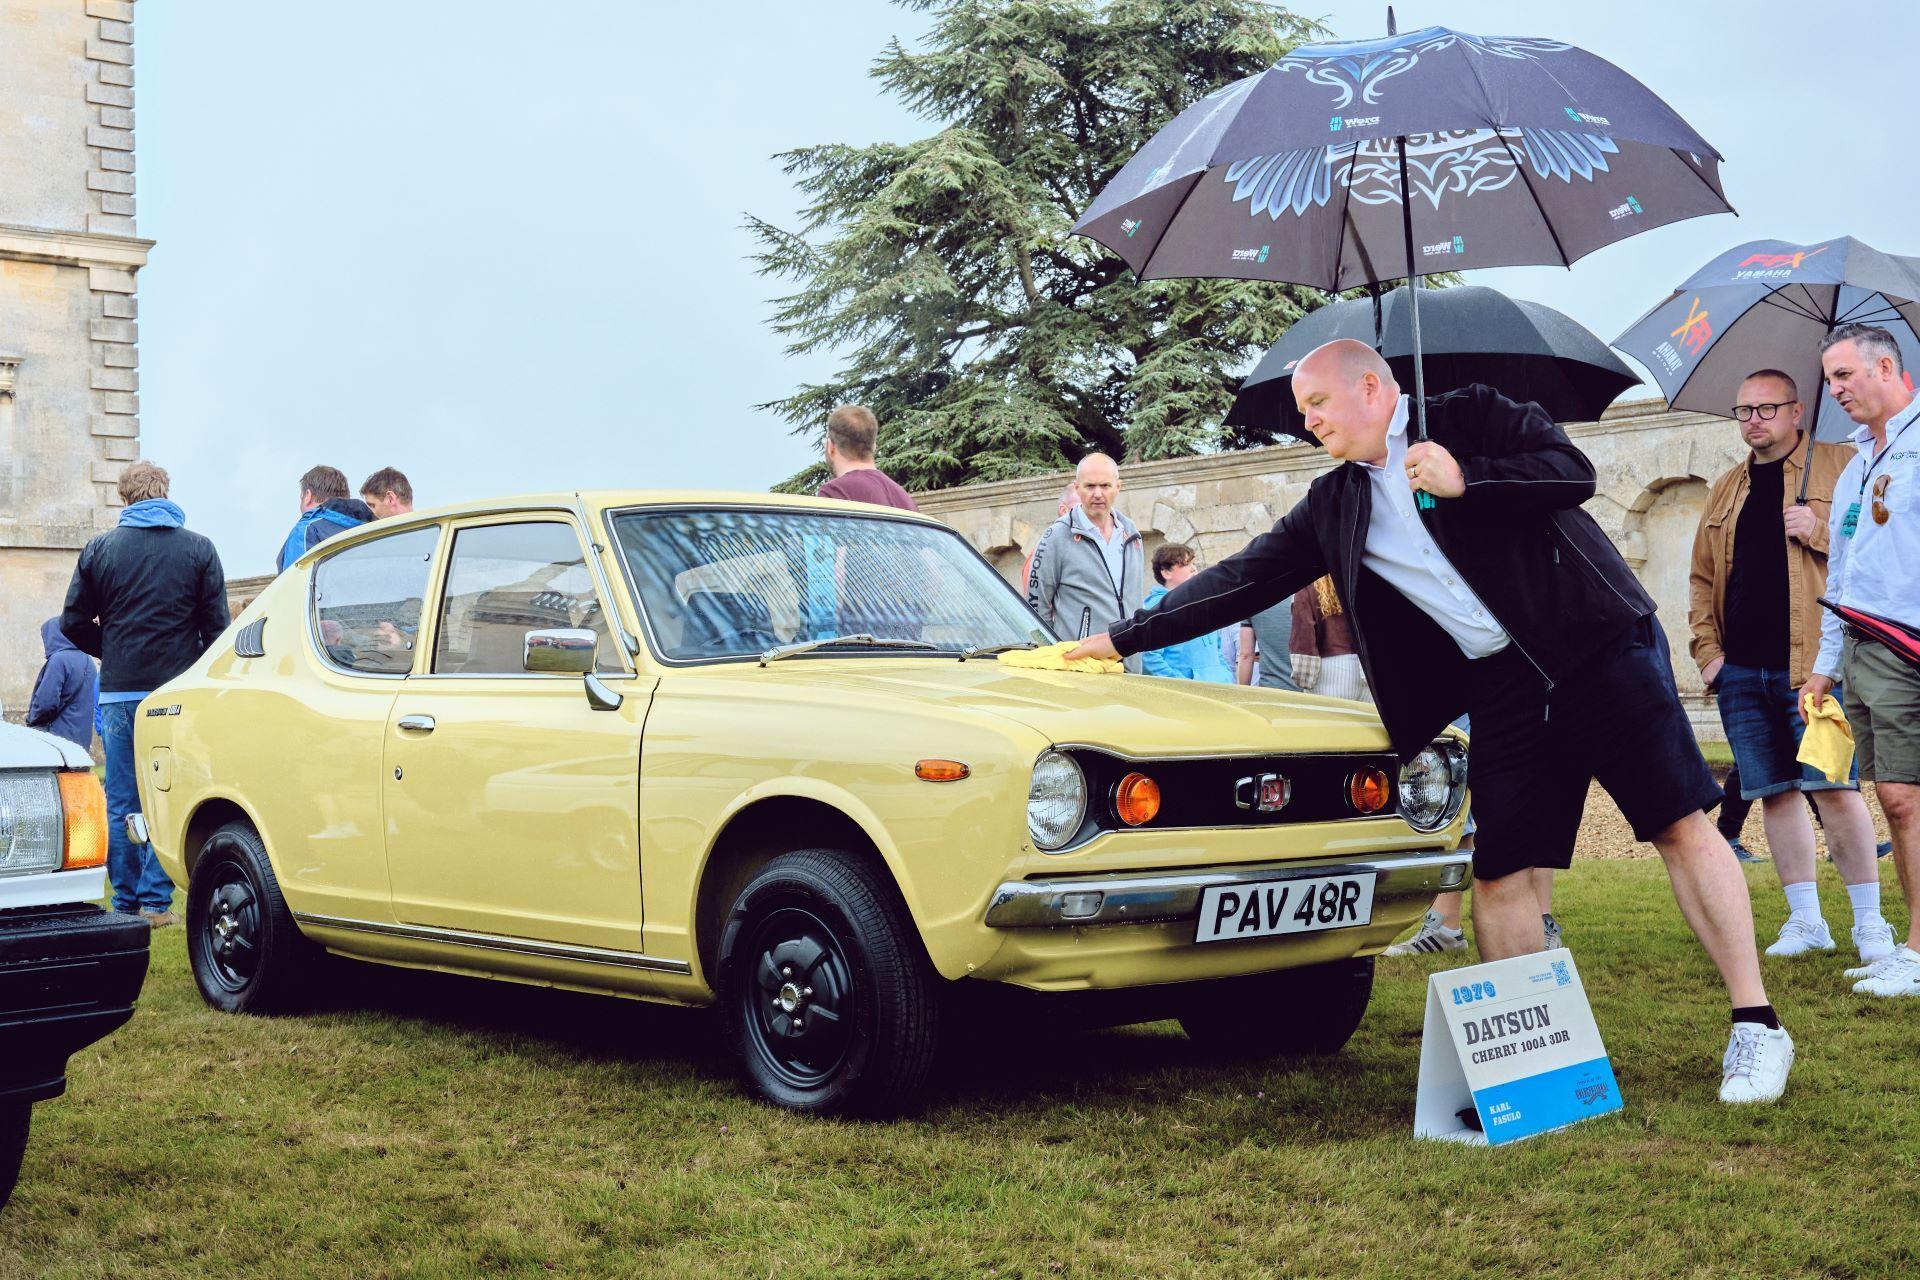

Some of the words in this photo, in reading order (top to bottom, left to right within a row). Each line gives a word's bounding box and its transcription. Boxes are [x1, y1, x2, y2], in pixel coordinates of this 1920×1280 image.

[1736, 269, 1792, 278] YAMAHA
[1213, 887, 1289, 935] PAV
[1293, 880, 1361, 927] 48R
[1451, 980, 1496, 1006] 1976
[1463, 1004, 1551, 1046] DATSUN
[1471, 1042, 1518, 1065] CHERRY
[1520, 1036, 1547, 1053] 100A
[1548, 1029, 1571, 1046] 3DR
[1489, 1101, 1512, 1115] KARL
[1492, 1110, 1522, 1127] FASULO
